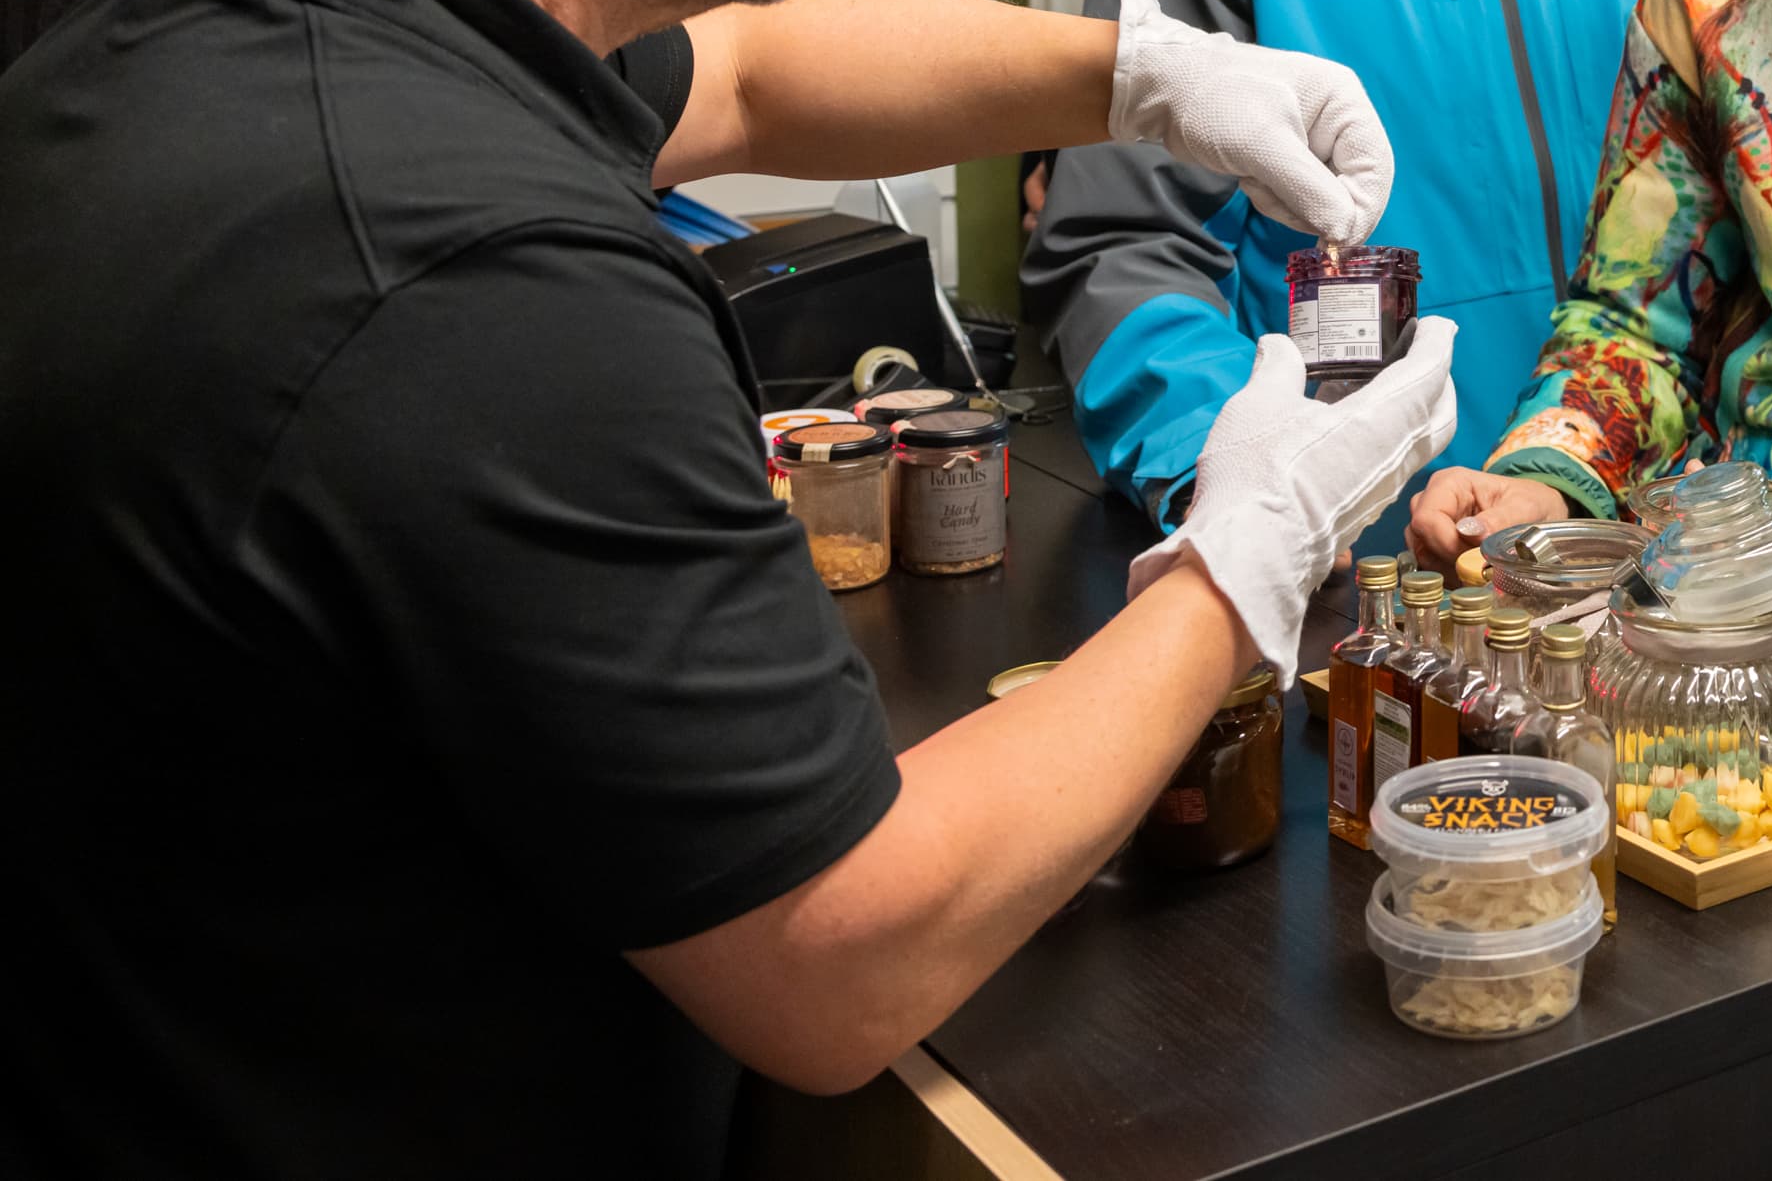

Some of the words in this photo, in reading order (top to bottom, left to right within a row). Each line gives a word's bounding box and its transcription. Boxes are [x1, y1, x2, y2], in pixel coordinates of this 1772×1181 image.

[943, 496, 978, 517] Hard
[940, 513, 981, 532] Candy
[1429, 796, 1555, 813] VIKING
[1423, 812, 1548, 828] SNACK
